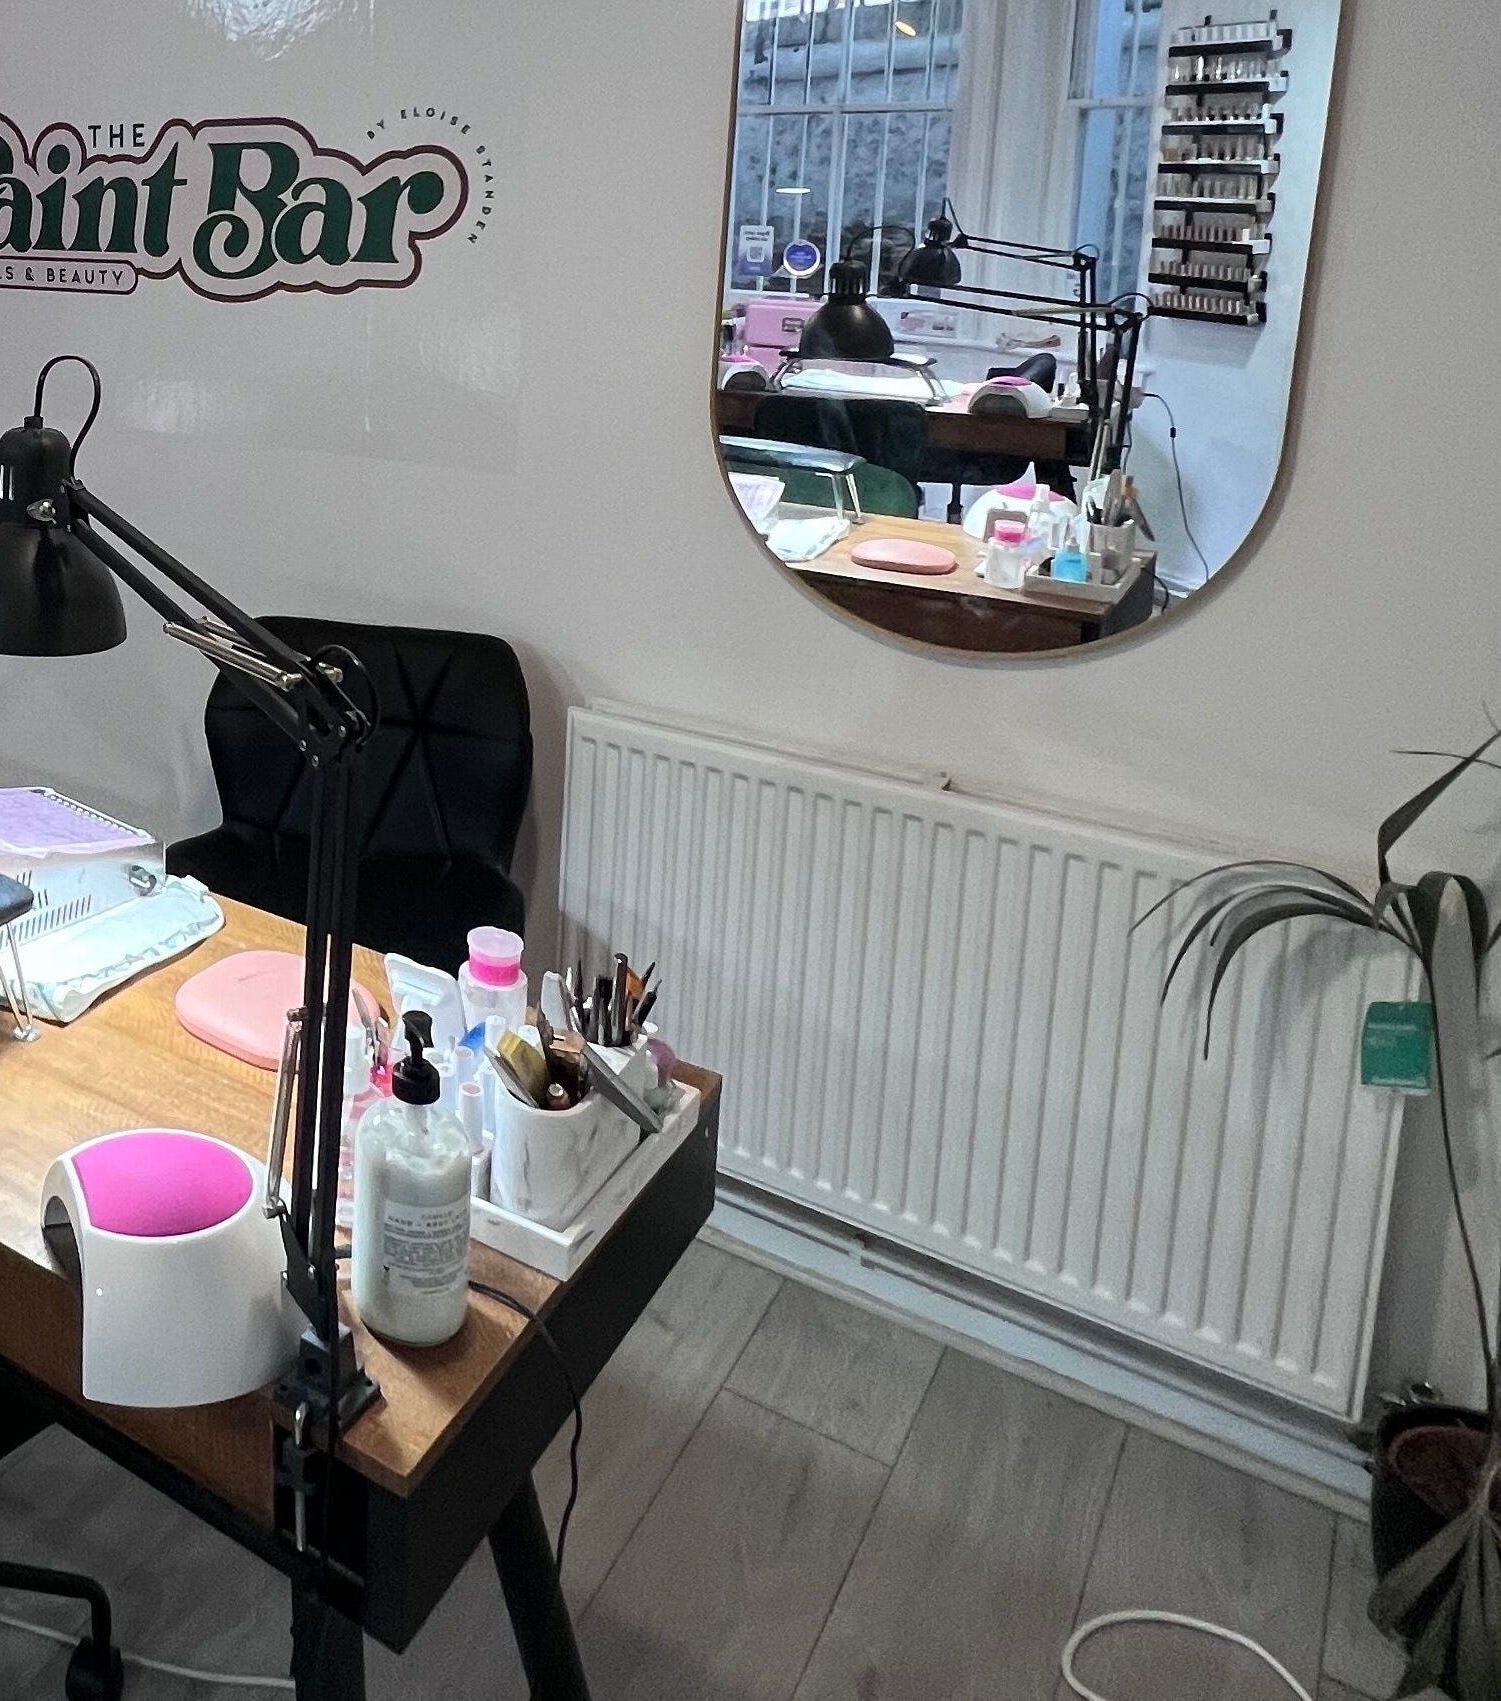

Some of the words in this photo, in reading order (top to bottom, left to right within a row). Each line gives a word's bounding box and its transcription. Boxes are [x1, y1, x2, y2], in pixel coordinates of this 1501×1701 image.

[87, 123, 146, 149] THE
[366, 119, 385, 139] BY
[400, 106, 471, 134] ELOISE
[467, 145, 494, 244] STANDEN
[192, 141, 445, 280] Bar
[25, 266, 35, 281] &
[46, 267, 124, 285] BEAUTY
